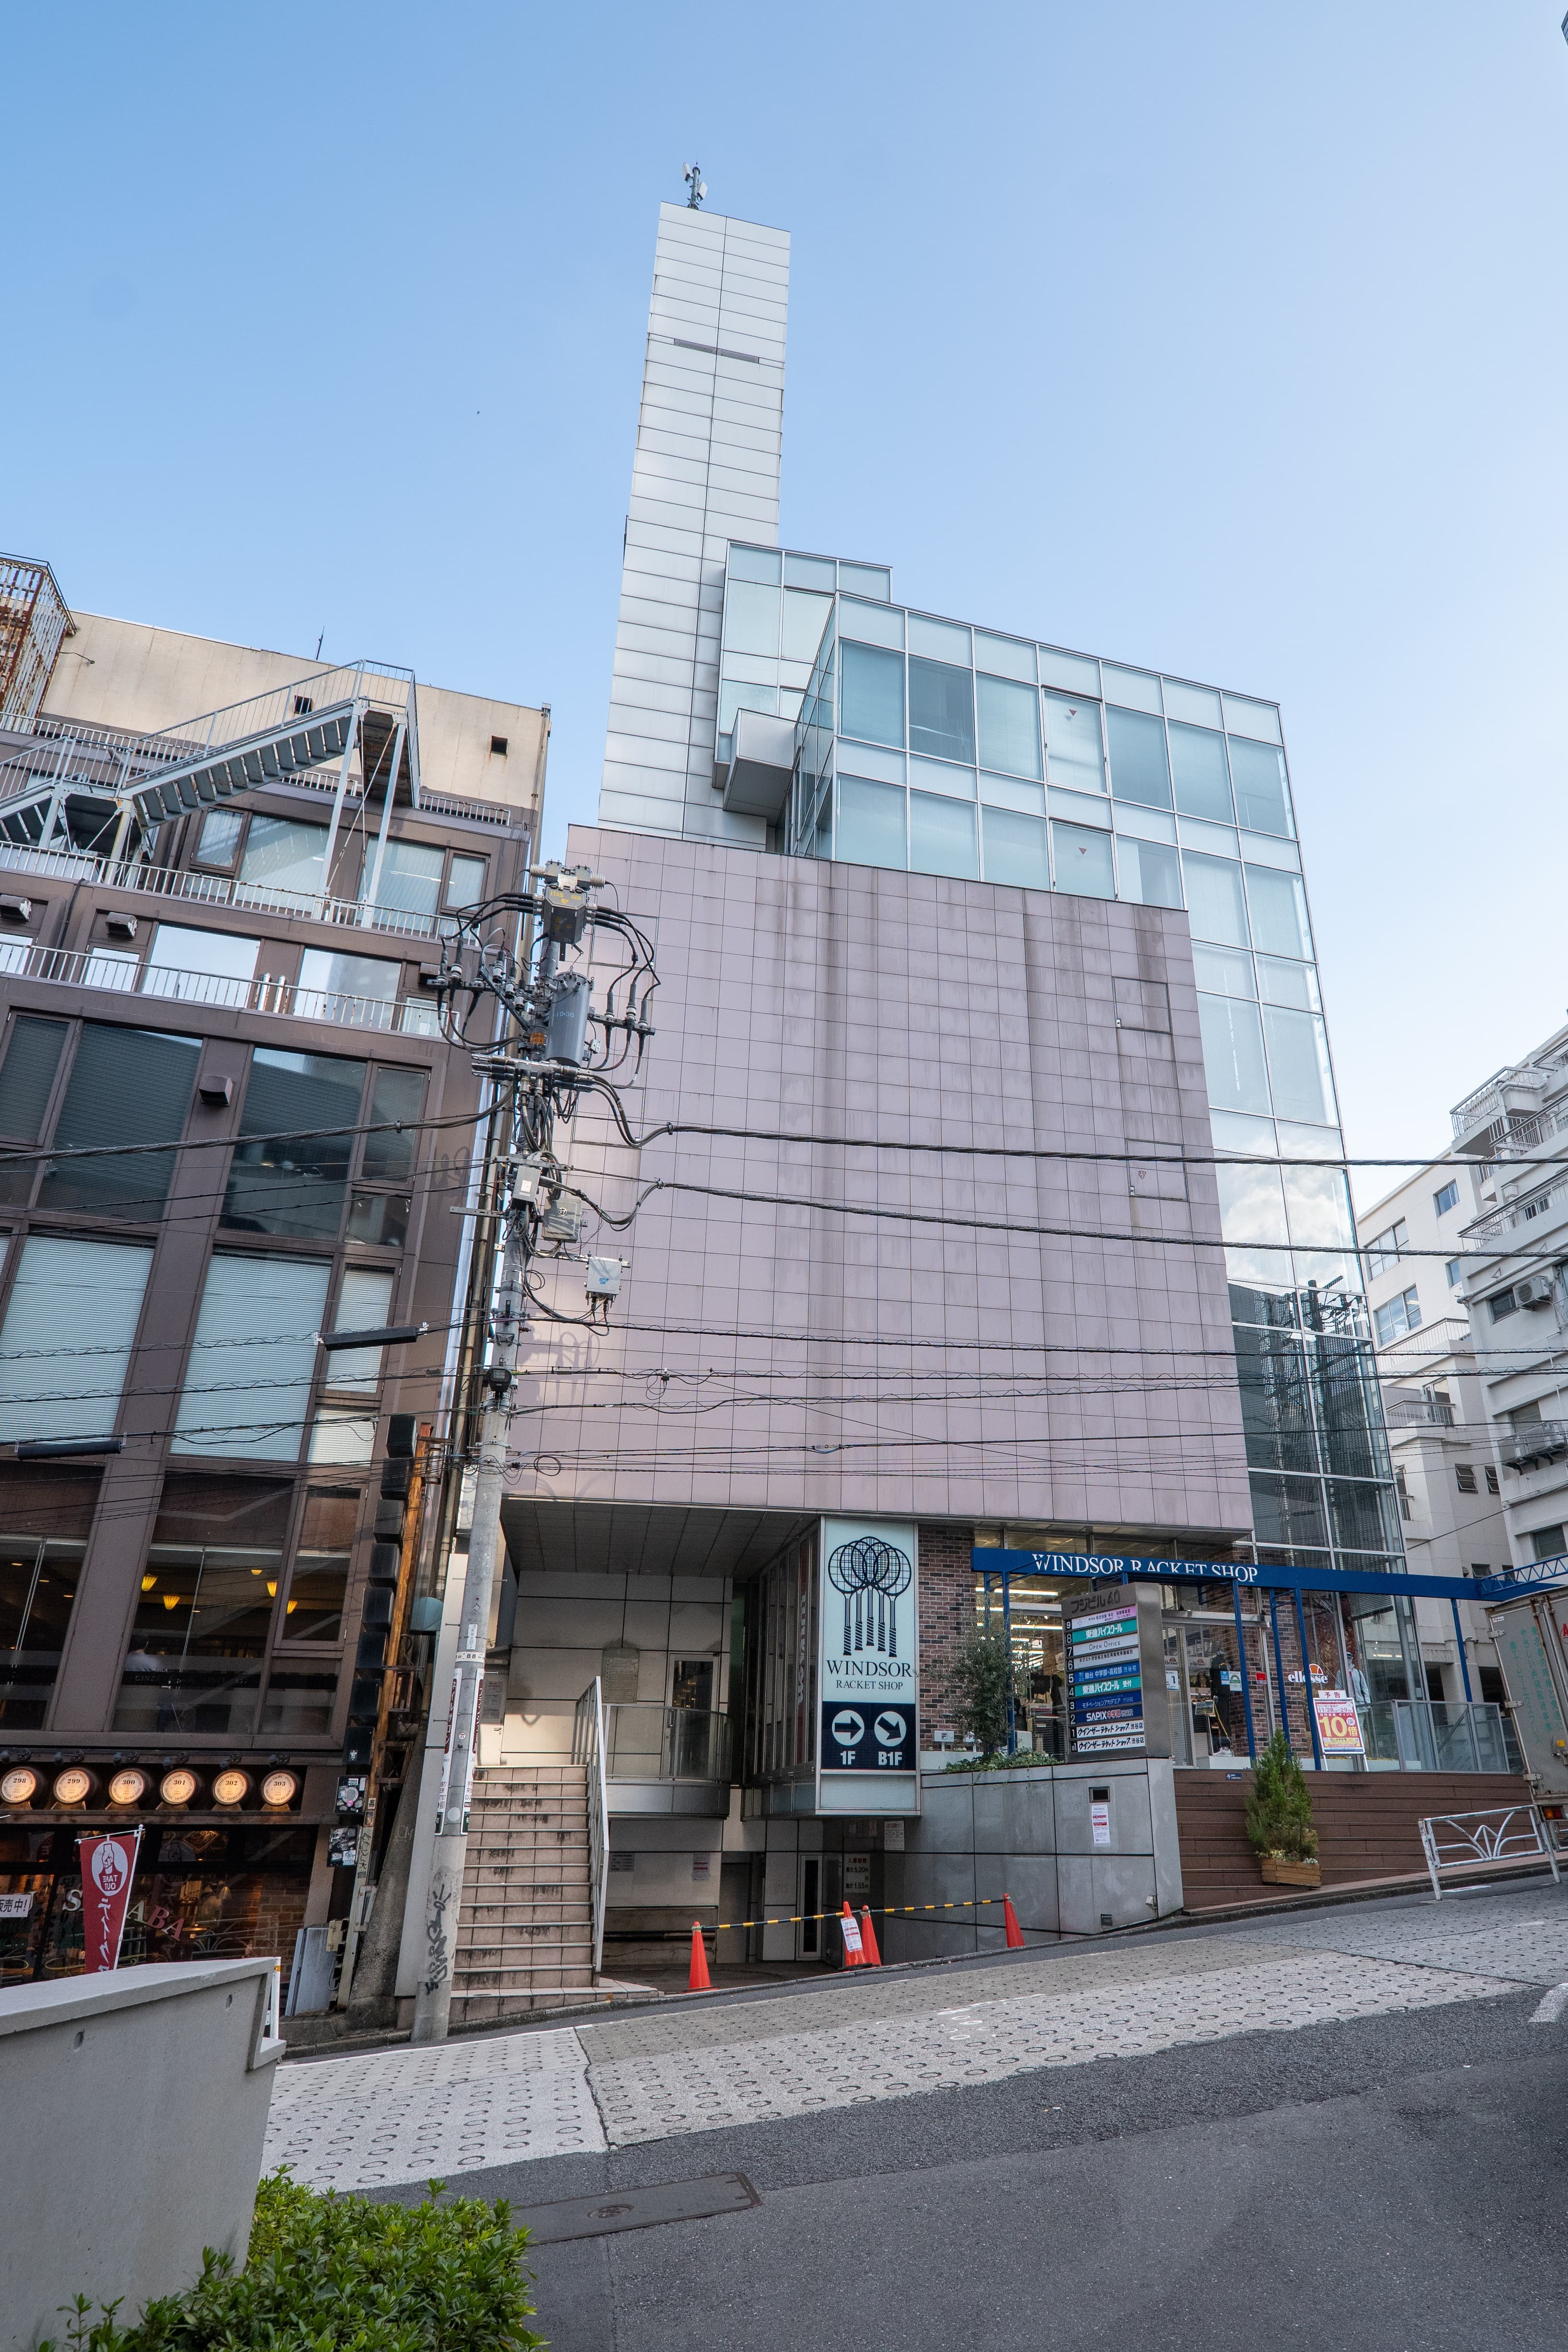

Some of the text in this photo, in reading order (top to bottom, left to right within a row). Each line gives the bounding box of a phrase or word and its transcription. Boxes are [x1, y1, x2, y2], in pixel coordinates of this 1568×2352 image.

[1032, 1554, 1124, 1574] WINDSOR
[1067, 1623, 1122, 1643] 8 東進ハイスクール
[1067, 1647, 1072, 1657] 7
[826, 1660, 913, 1677] WINDSOR
[1068, 1660, 1073, 1670] 6
[1069, 1673, 1074, 1683] 5
[836, 1680, 903, 1690] RACKET SHOP
[1069, 1680, 1132, 1696] 4 東進ハイスクール 受付
[1070, 1702, 1075, 1710] 3
[1082, 1698, 1121, 1708] モチベーションアカデミア
[1070, 1714, 1076, 1725] 2
[1072, 1729, 1075, 1737] 1
[1319, 1716, 1358, 1737] 10 倍
[841, 1751, 855, 1765] 1F
[878, 1751, 902, 1766] B1F
